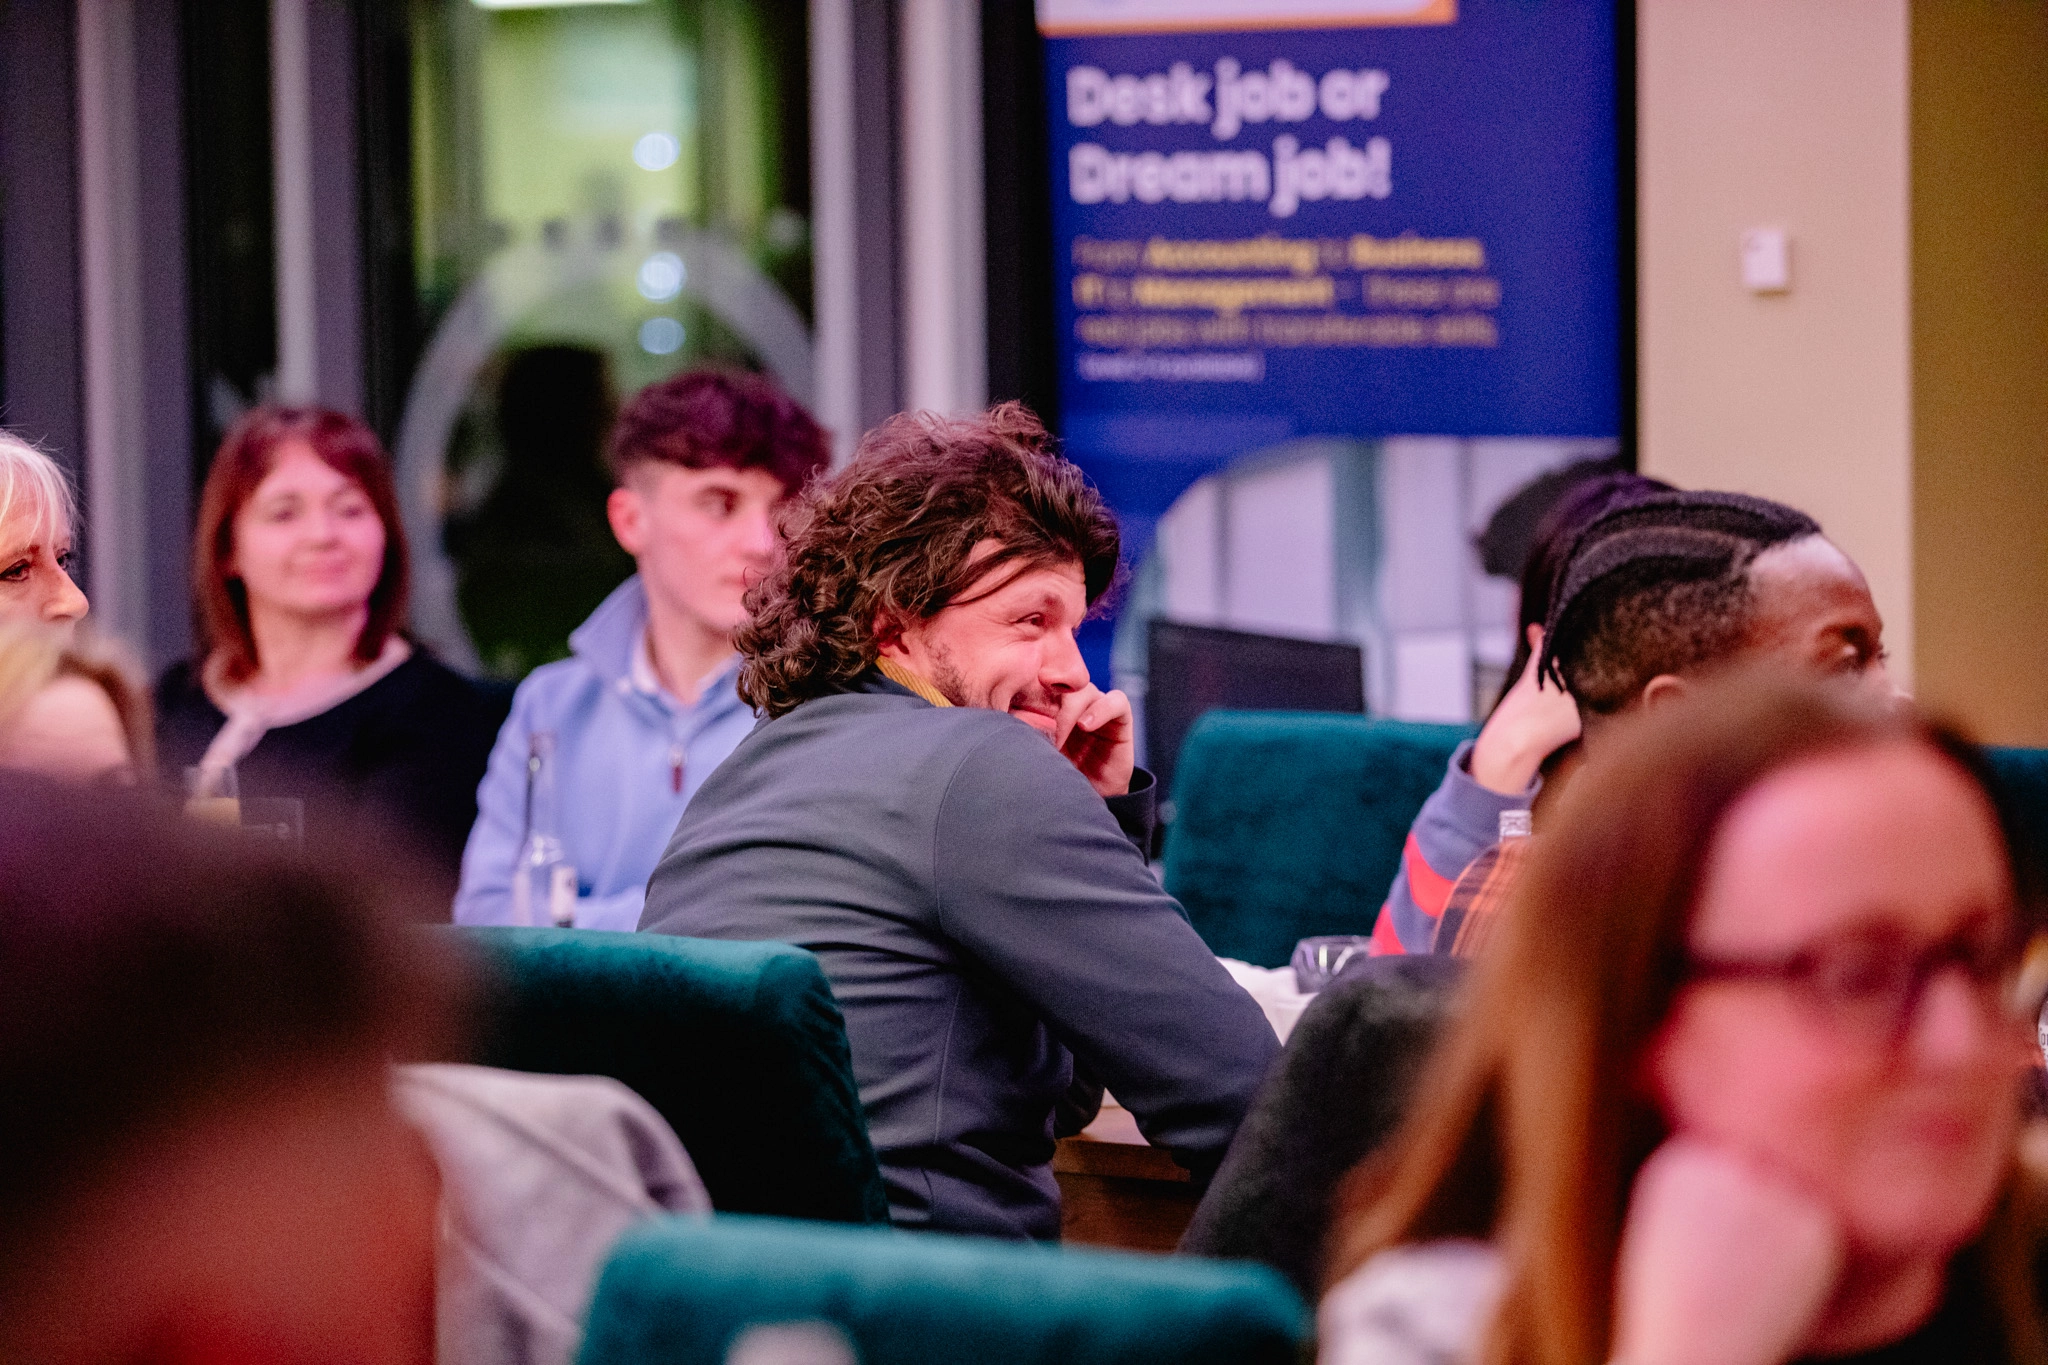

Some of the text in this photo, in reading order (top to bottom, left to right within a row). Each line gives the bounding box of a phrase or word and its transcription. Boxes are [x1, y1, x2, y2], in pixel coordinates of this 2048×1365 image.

[1067, 58, 1389, 139] Desk job or
[1068, 134, 1391, 216] Dream job!
[1144, 236, 1318, 275] Accounting
[1133, 276, 1334, 315] Management
